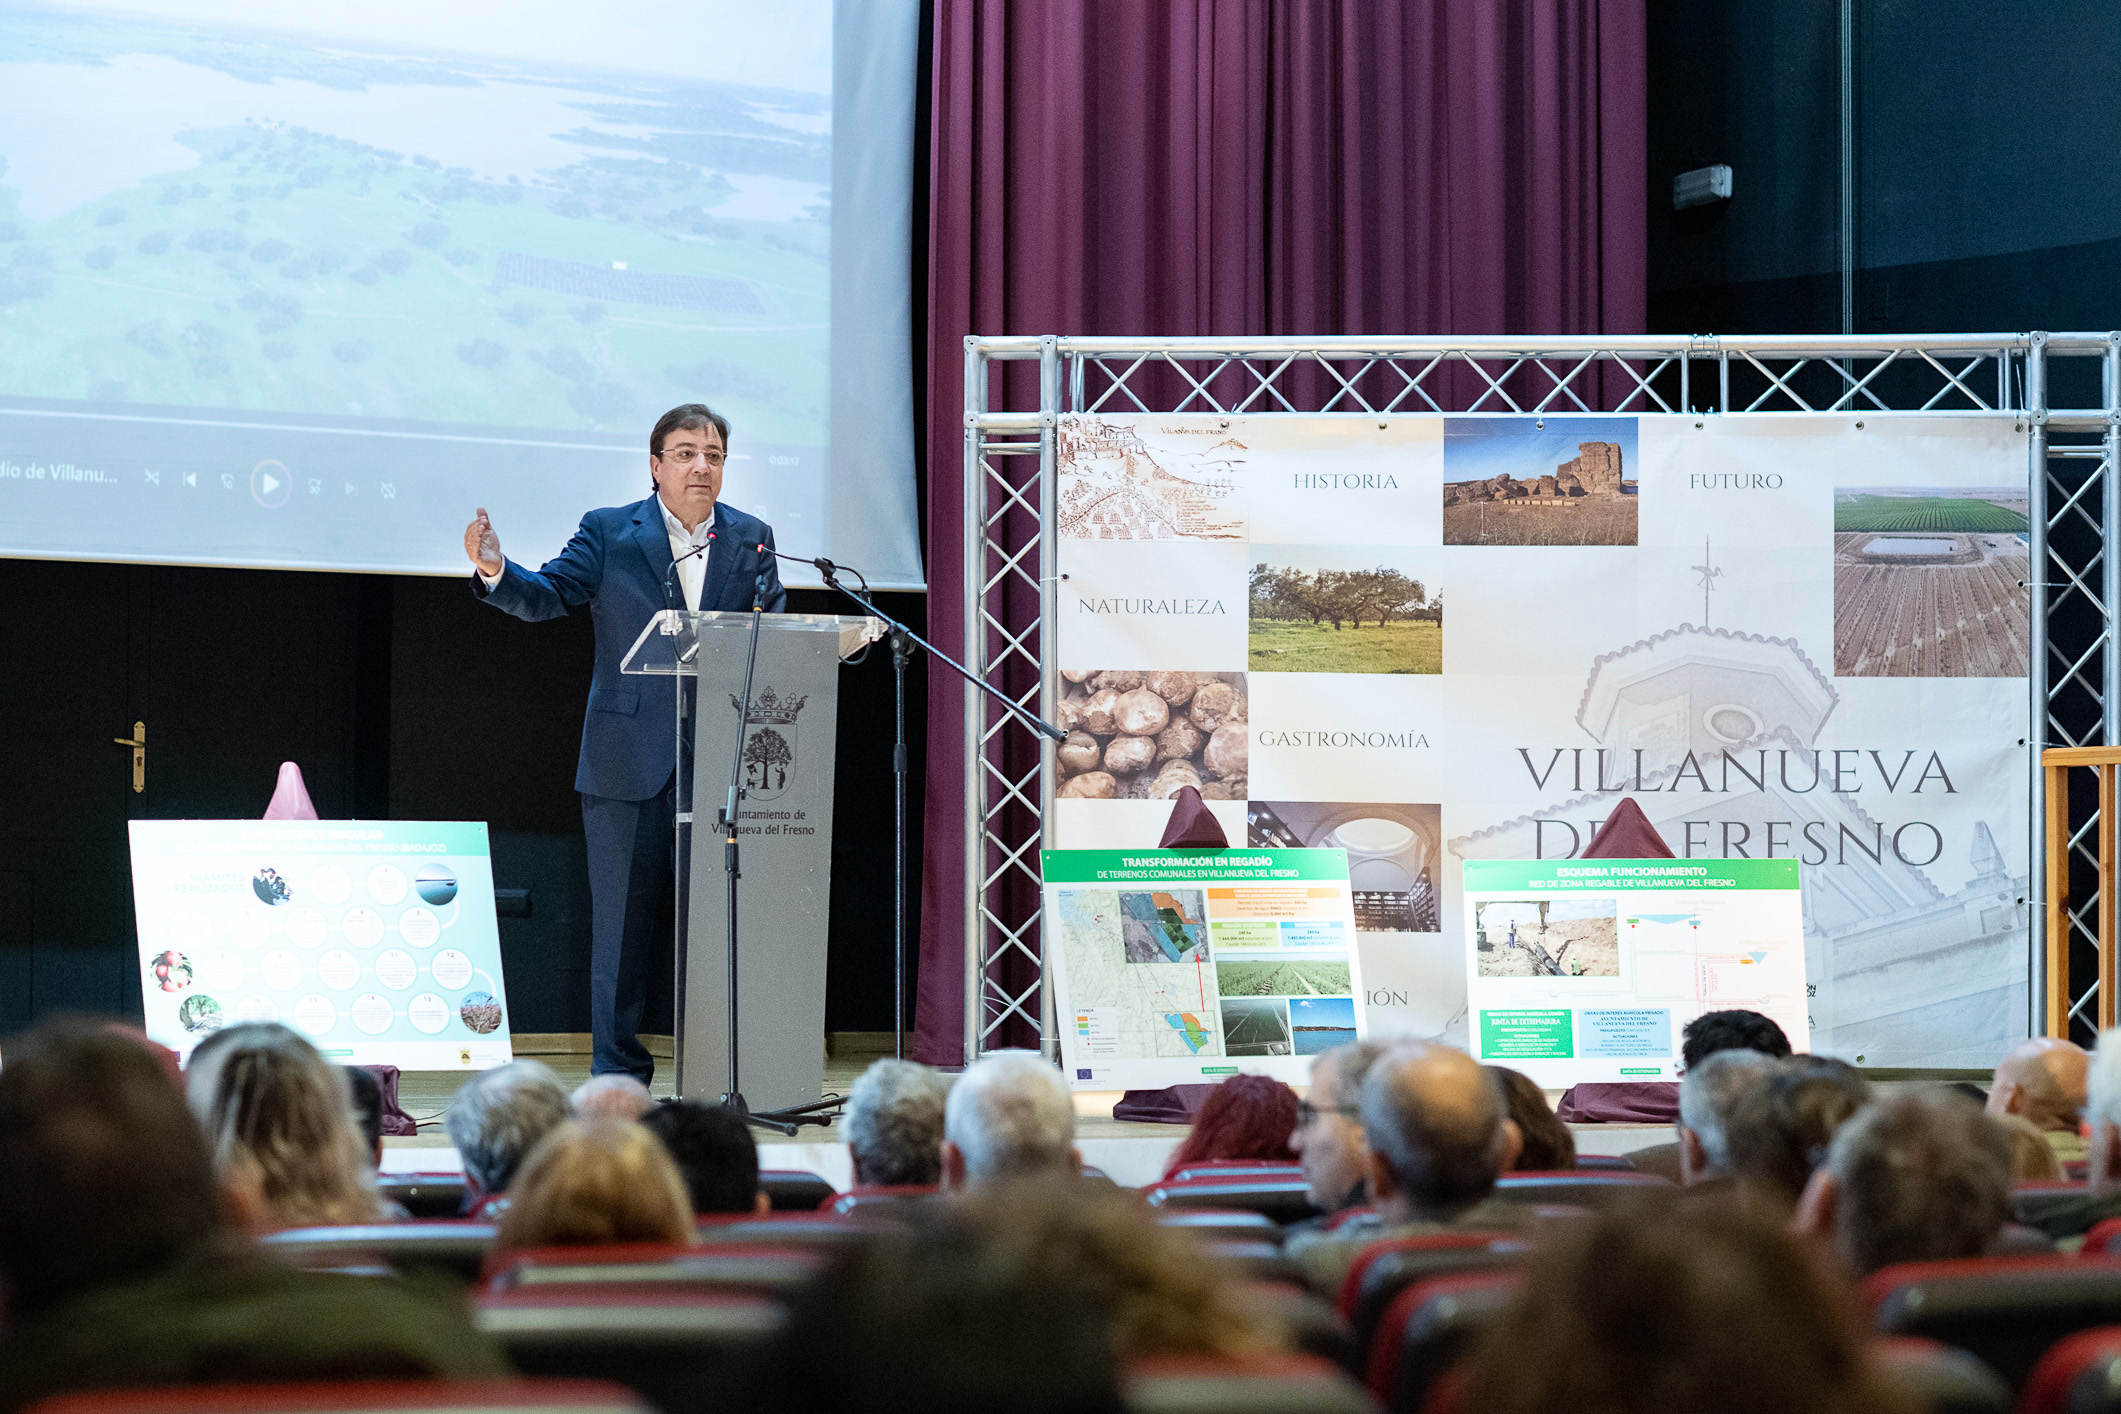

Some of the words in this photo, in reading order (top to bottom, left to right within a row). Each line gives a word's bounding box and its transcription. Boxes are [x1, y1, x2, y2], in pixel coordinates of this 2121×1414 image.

[25, 462, 45, 479] de
[1294, 473, 1398, 489] HISTORIA
[1690, 473, 1783, 490] FUTURO
[1078, 598, 1226, 615] NATURALEZA
[1259, 729, 1430, 748] GASTRONOMÍA
[1515, 747, 1960, 794] VILLANUEVA
[794, 809, 806, 820] de
[765, 824, 779, 835] del
[783, 824, 815, 836] Fresno
[367, 844, 398, 853] FRESNO
[401, 844, 446, 853] (BADAJOZ)
[1681, 819, 1944, 867] FRESNO
[1122, 857, 1213, 868] TRANSFORMACIÓN
[1216, 858, 1228, 867] EN
[1230, 856, 1273, 867] REGADÍO
[188, 872, 245, 881] TRÁMITES
[1097, 871, 1108, 879] DE
[1109, 871, 1147, 880] TERRENOS
[1148, 870, 1196, 879] COMUNALES
[1198, 870, 1207, 878] EN
[1208, 870, 1254, 879] VILLANUEVA
[1255, 870, 1269, 878] DEL
[1270, 869, 1299, 878] FRESNO
[1557, 868, 1609, 878] ESQUEMA
[1611, 867, 1707, 877] FUNCIONAMIENTO
[174, 883, 246, 894] REALIZADOS
[1547, 880, 1559, 888] DE
[1560, 880, 1583, 888] ZONA
[1585, 880, 1621, 888] REGABLE
[1623, 879, 1634, 887] DE
[1635, 879, 1685, 888] VILLANUEVA
[1687, 879, 1702, 887] DEL
[1704, 879, 1736, 887] FRESNO
